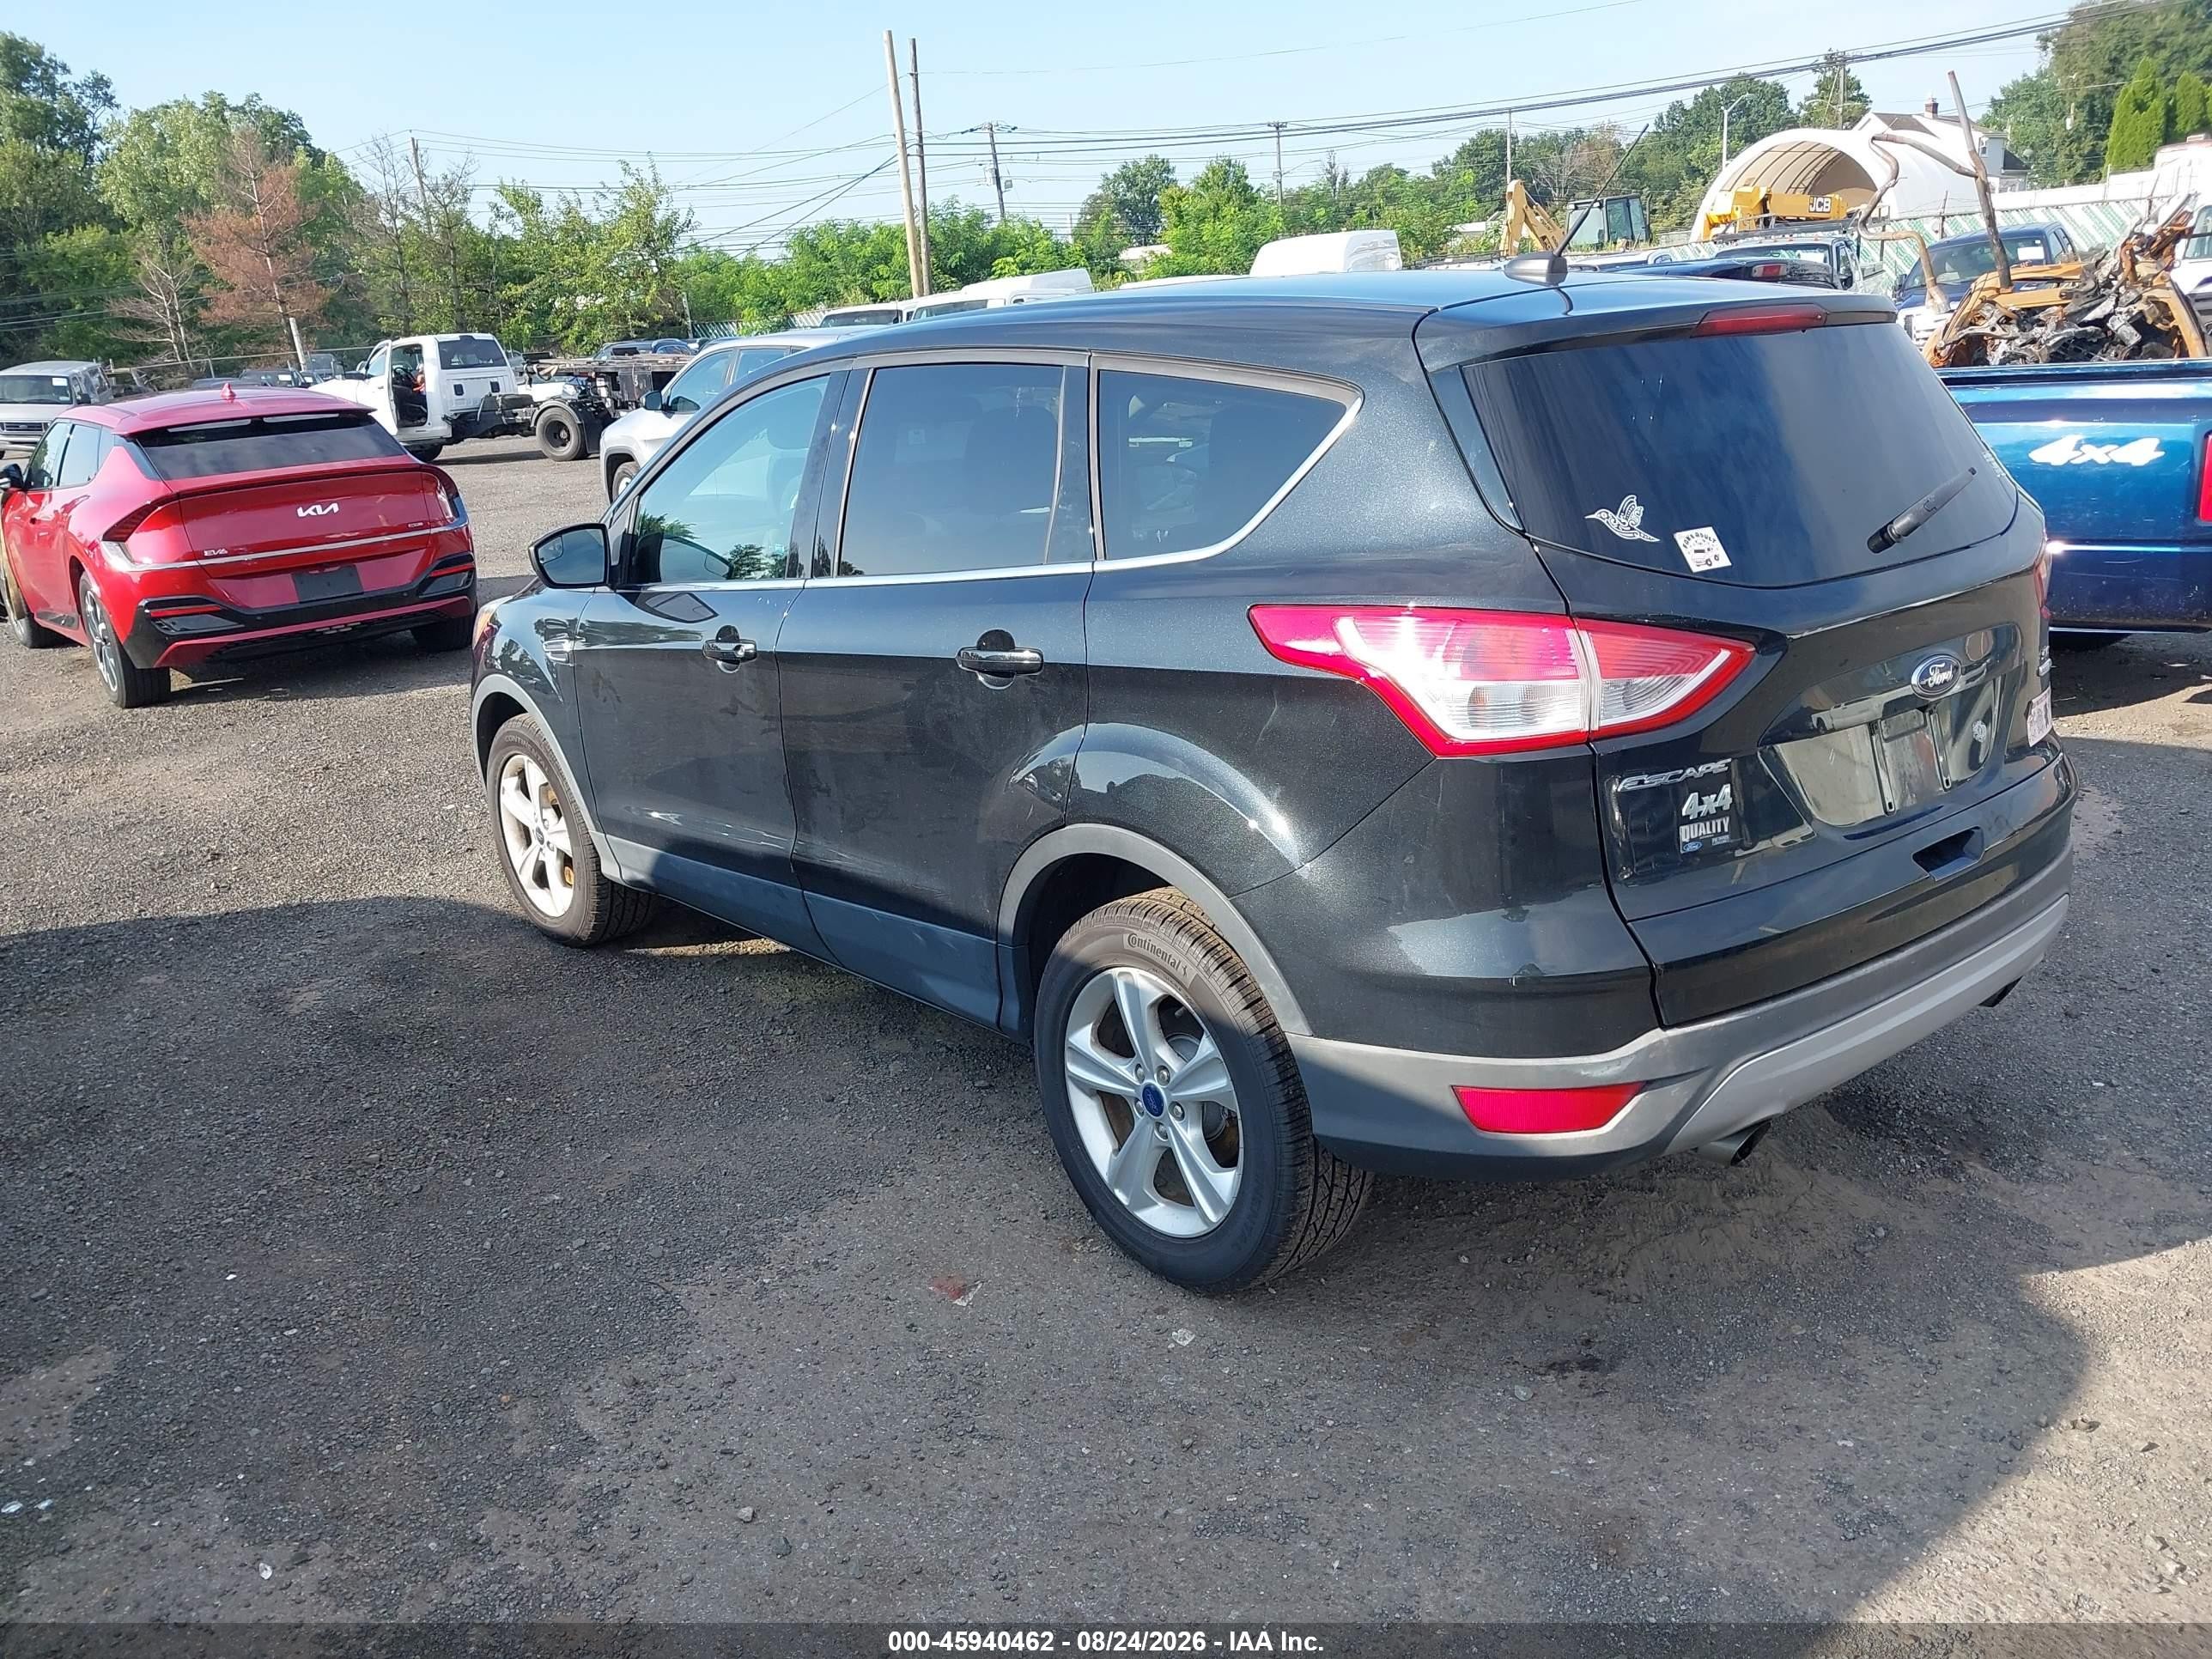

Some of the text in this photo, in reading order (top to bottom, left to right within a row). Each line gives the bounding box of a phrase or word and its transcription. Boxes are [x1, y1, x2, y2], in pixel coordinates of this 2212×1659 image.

[1809, 197, 1831, 212] JCB
[2028, 434, 2166, 466] 4x4
[297, 501, 339, 517] KIA
[1920, 662, 1954, 688] Ford
[1617, 757, 1732, 793] ESCAPE
[1681, 783, 1733, 820] 4x4
[1681, 816, 1730, 842] QUALITY
[1127, 933, 1182, 971] Continental
